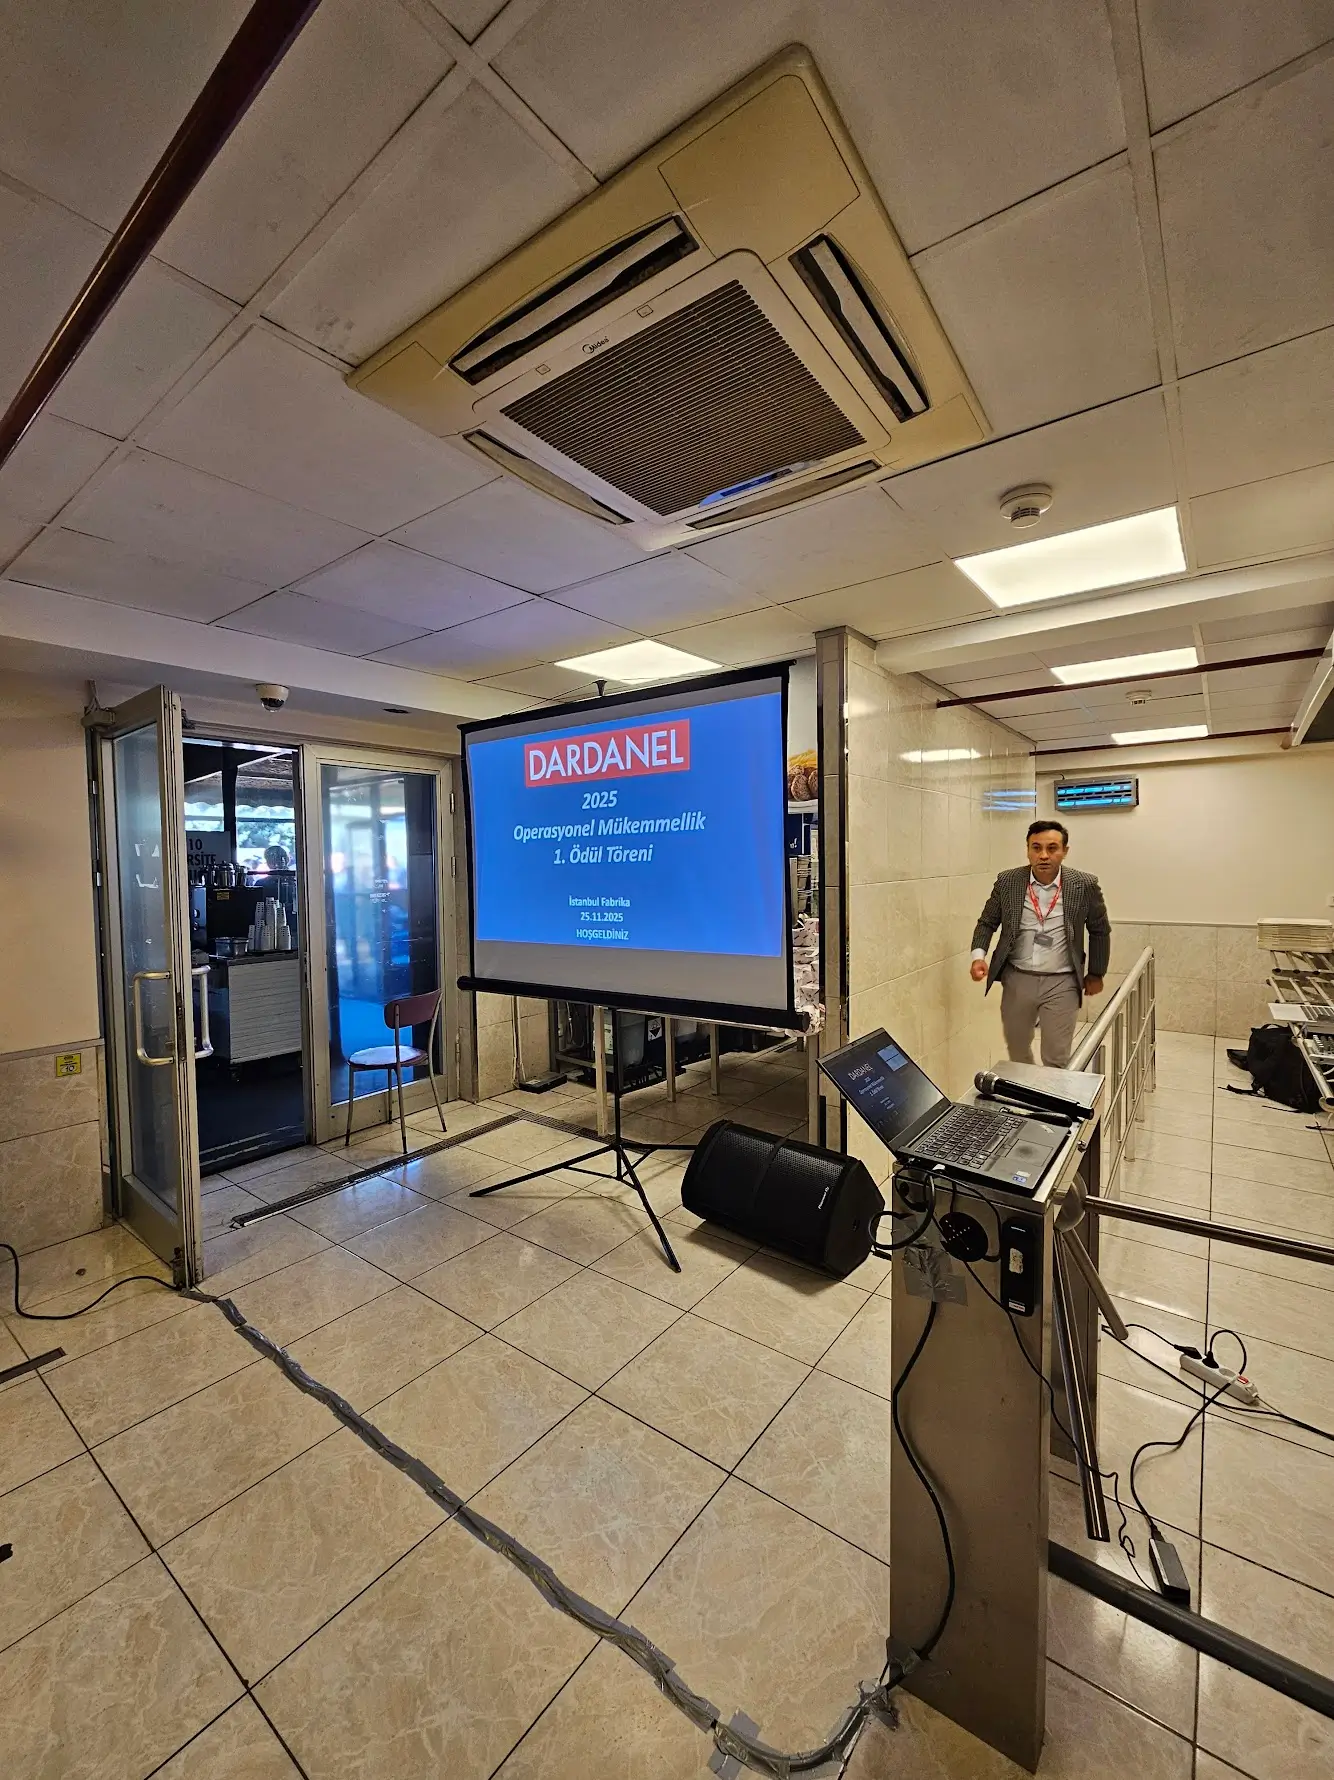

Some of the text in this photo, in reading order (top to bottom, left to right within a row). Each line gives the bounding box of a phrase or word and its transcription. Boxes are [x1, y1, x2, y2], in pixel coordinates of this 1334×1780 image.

[582, 336, 610, 354] Midea
[529, 729, 684, 781] DARDANEL
[581, 790, 618, 810] 2025
[513, 811, 707, 843] Operasyonel Mükemmellik
[553, 844, 654, 865] 1. Ödül Töreni
[569, 895, 631, 907] İstanbul Fabrika
[580, 911, 624, 922] 25.11.2025
[576, 928, 629, 941] HOŞGELDİNİZ
